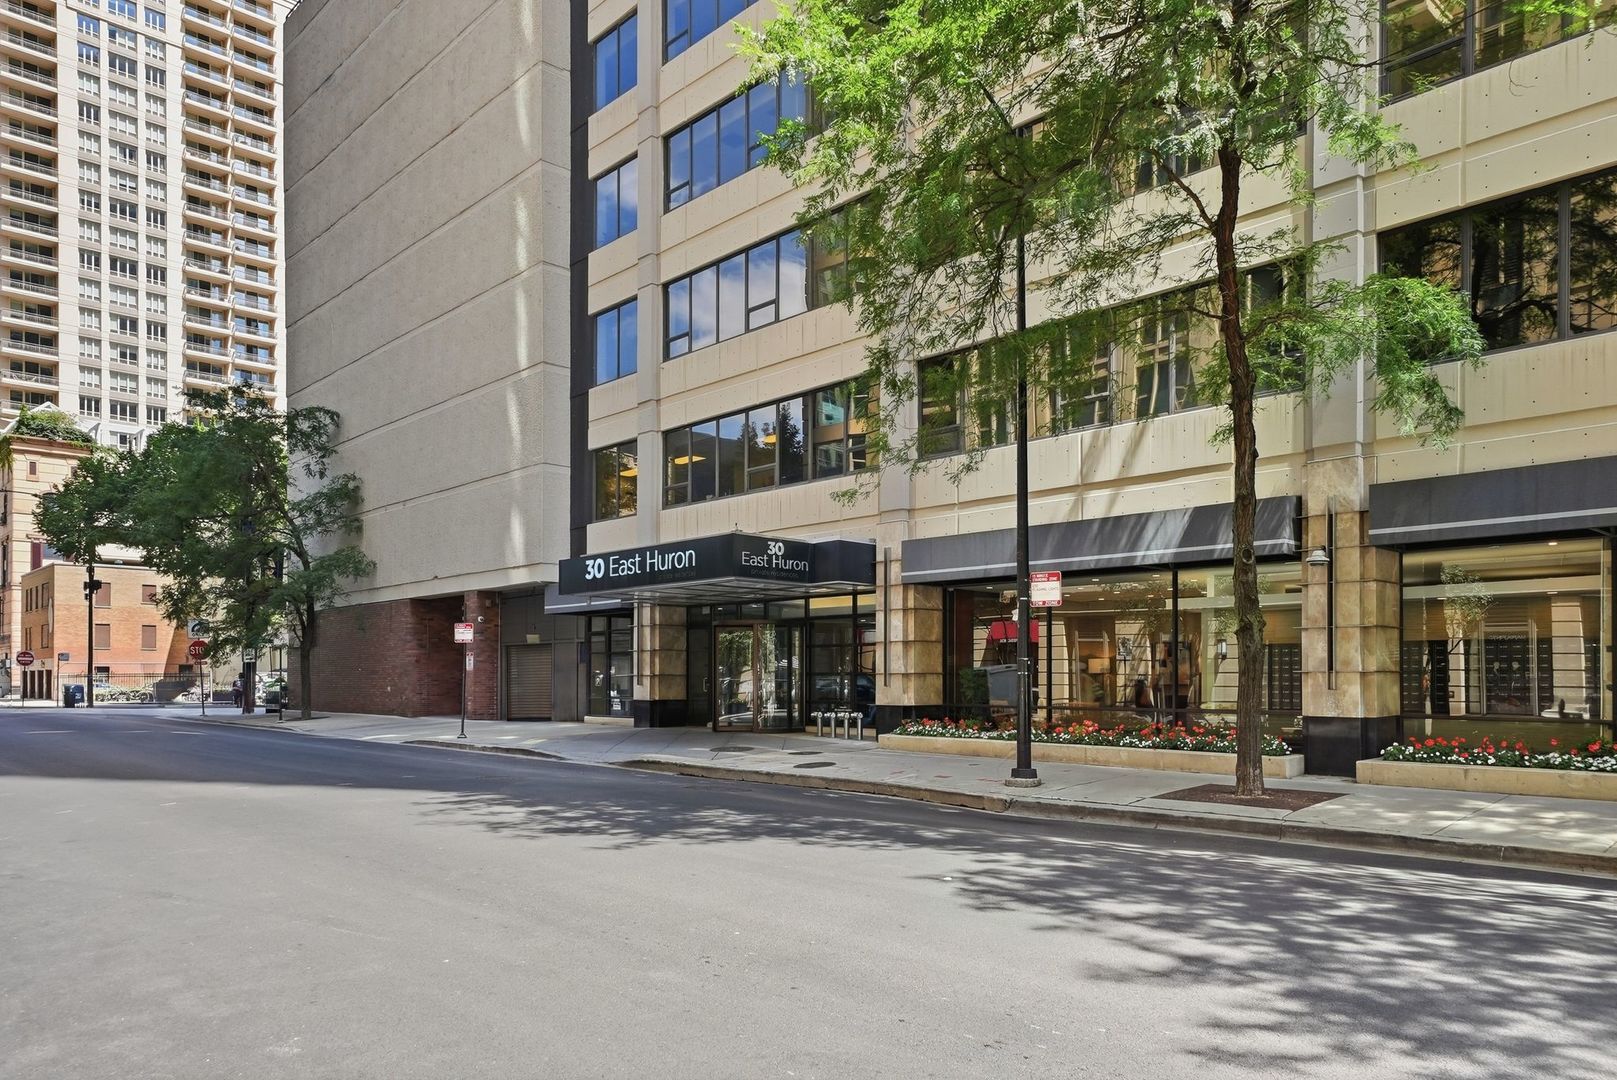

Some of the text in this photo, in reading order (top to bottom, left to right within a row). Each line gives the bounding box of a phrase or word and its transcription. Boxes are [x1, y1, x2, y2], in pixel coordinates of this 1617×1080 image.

[766, 541, 785, 556] 30
[585, 558, 605, 580] 30
[609, 555, 642, 577] East
[646, 549, 696, 572] Huron
[741, 551, 809, 572] East Huron
